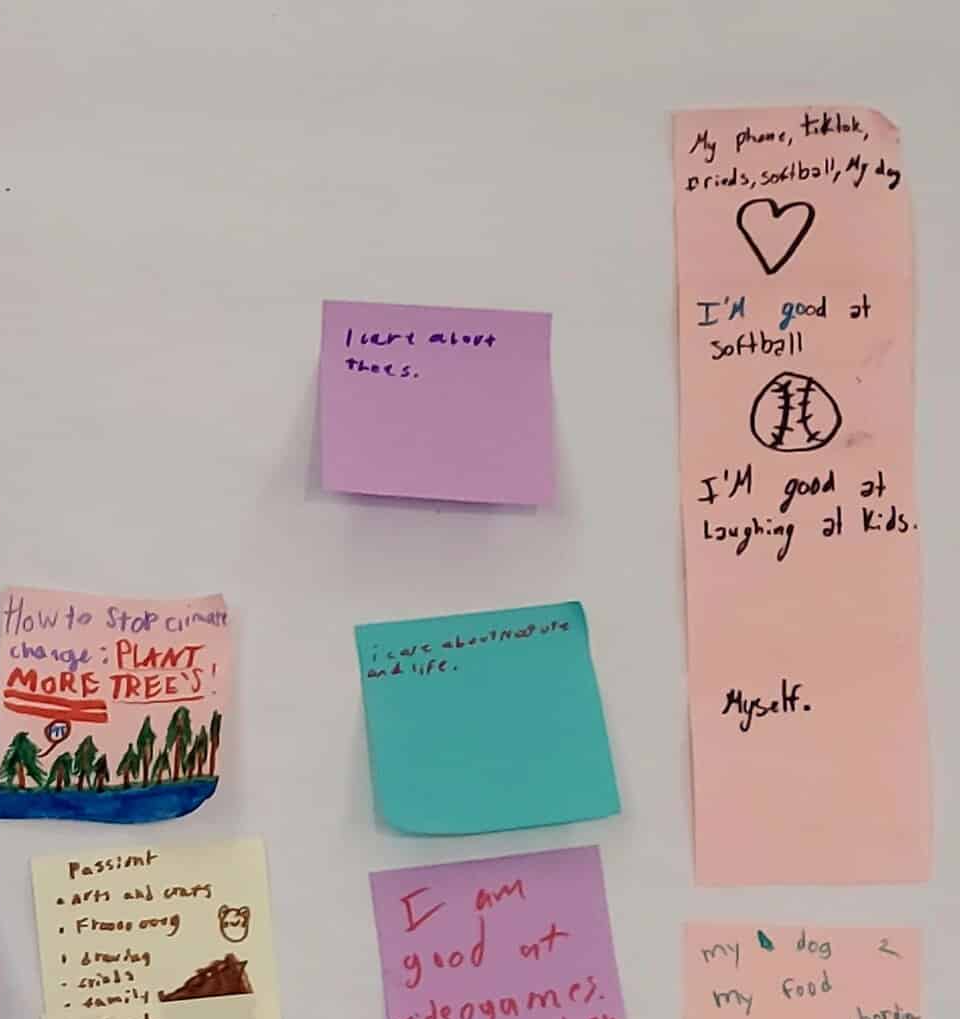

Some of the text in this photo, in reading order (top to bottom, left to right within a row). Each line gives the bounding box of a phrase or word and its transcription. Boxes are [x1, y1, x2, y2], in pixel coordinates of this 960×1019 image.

[690, 127, 793, 163] My phone,
[779, 294, 871, 330] good at
[779, 470, 886, 514] good at
[4, 595, 92, 635] How to
[116, 639, 205, 669] PLANT
[368, 663, 403, 678] and
[6, 668, 101, 697] MORE
[722, 679, 811, 732] Myself.
[400, 879, 525, 932] I am
[403, 915, 571, 989] good at
[701, 929, 832, 968] my dog
[713, 970, 832, 1016] my food
